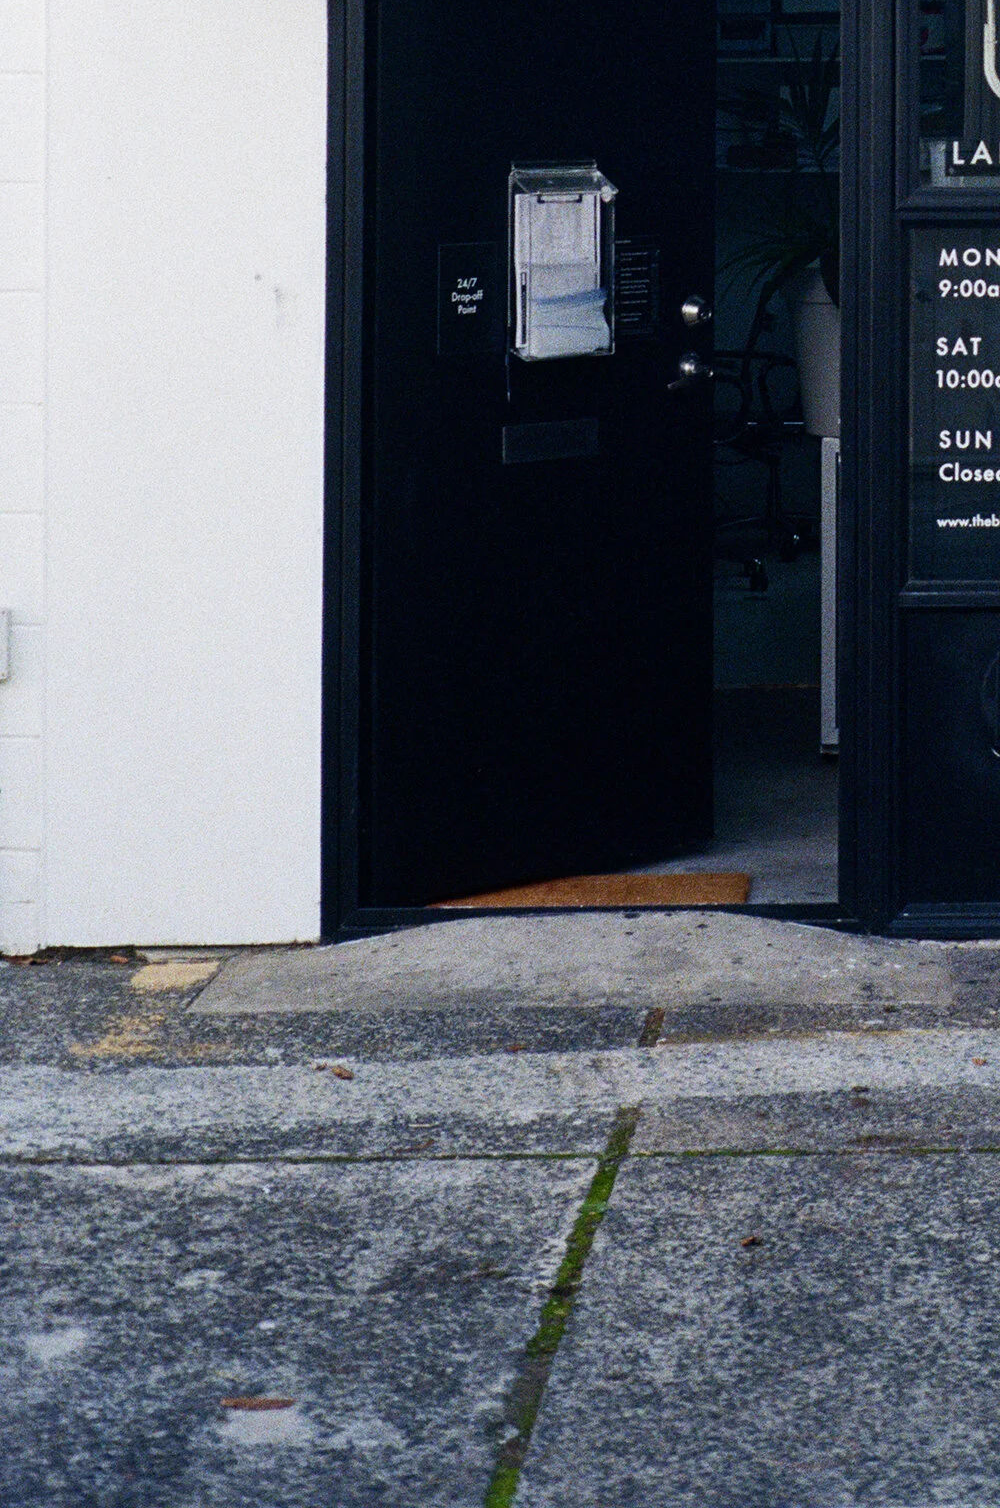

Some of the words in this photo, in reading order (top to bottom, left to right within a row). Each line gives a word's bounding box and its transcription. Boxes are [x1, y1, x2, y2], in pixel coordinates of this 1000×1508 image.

[457, 277, 478, 290] 24/7
[451, 289, 484, 304] Drop-off
[935, 336, 982, 357] SAT
[939, 429, 992, 450] SUN
